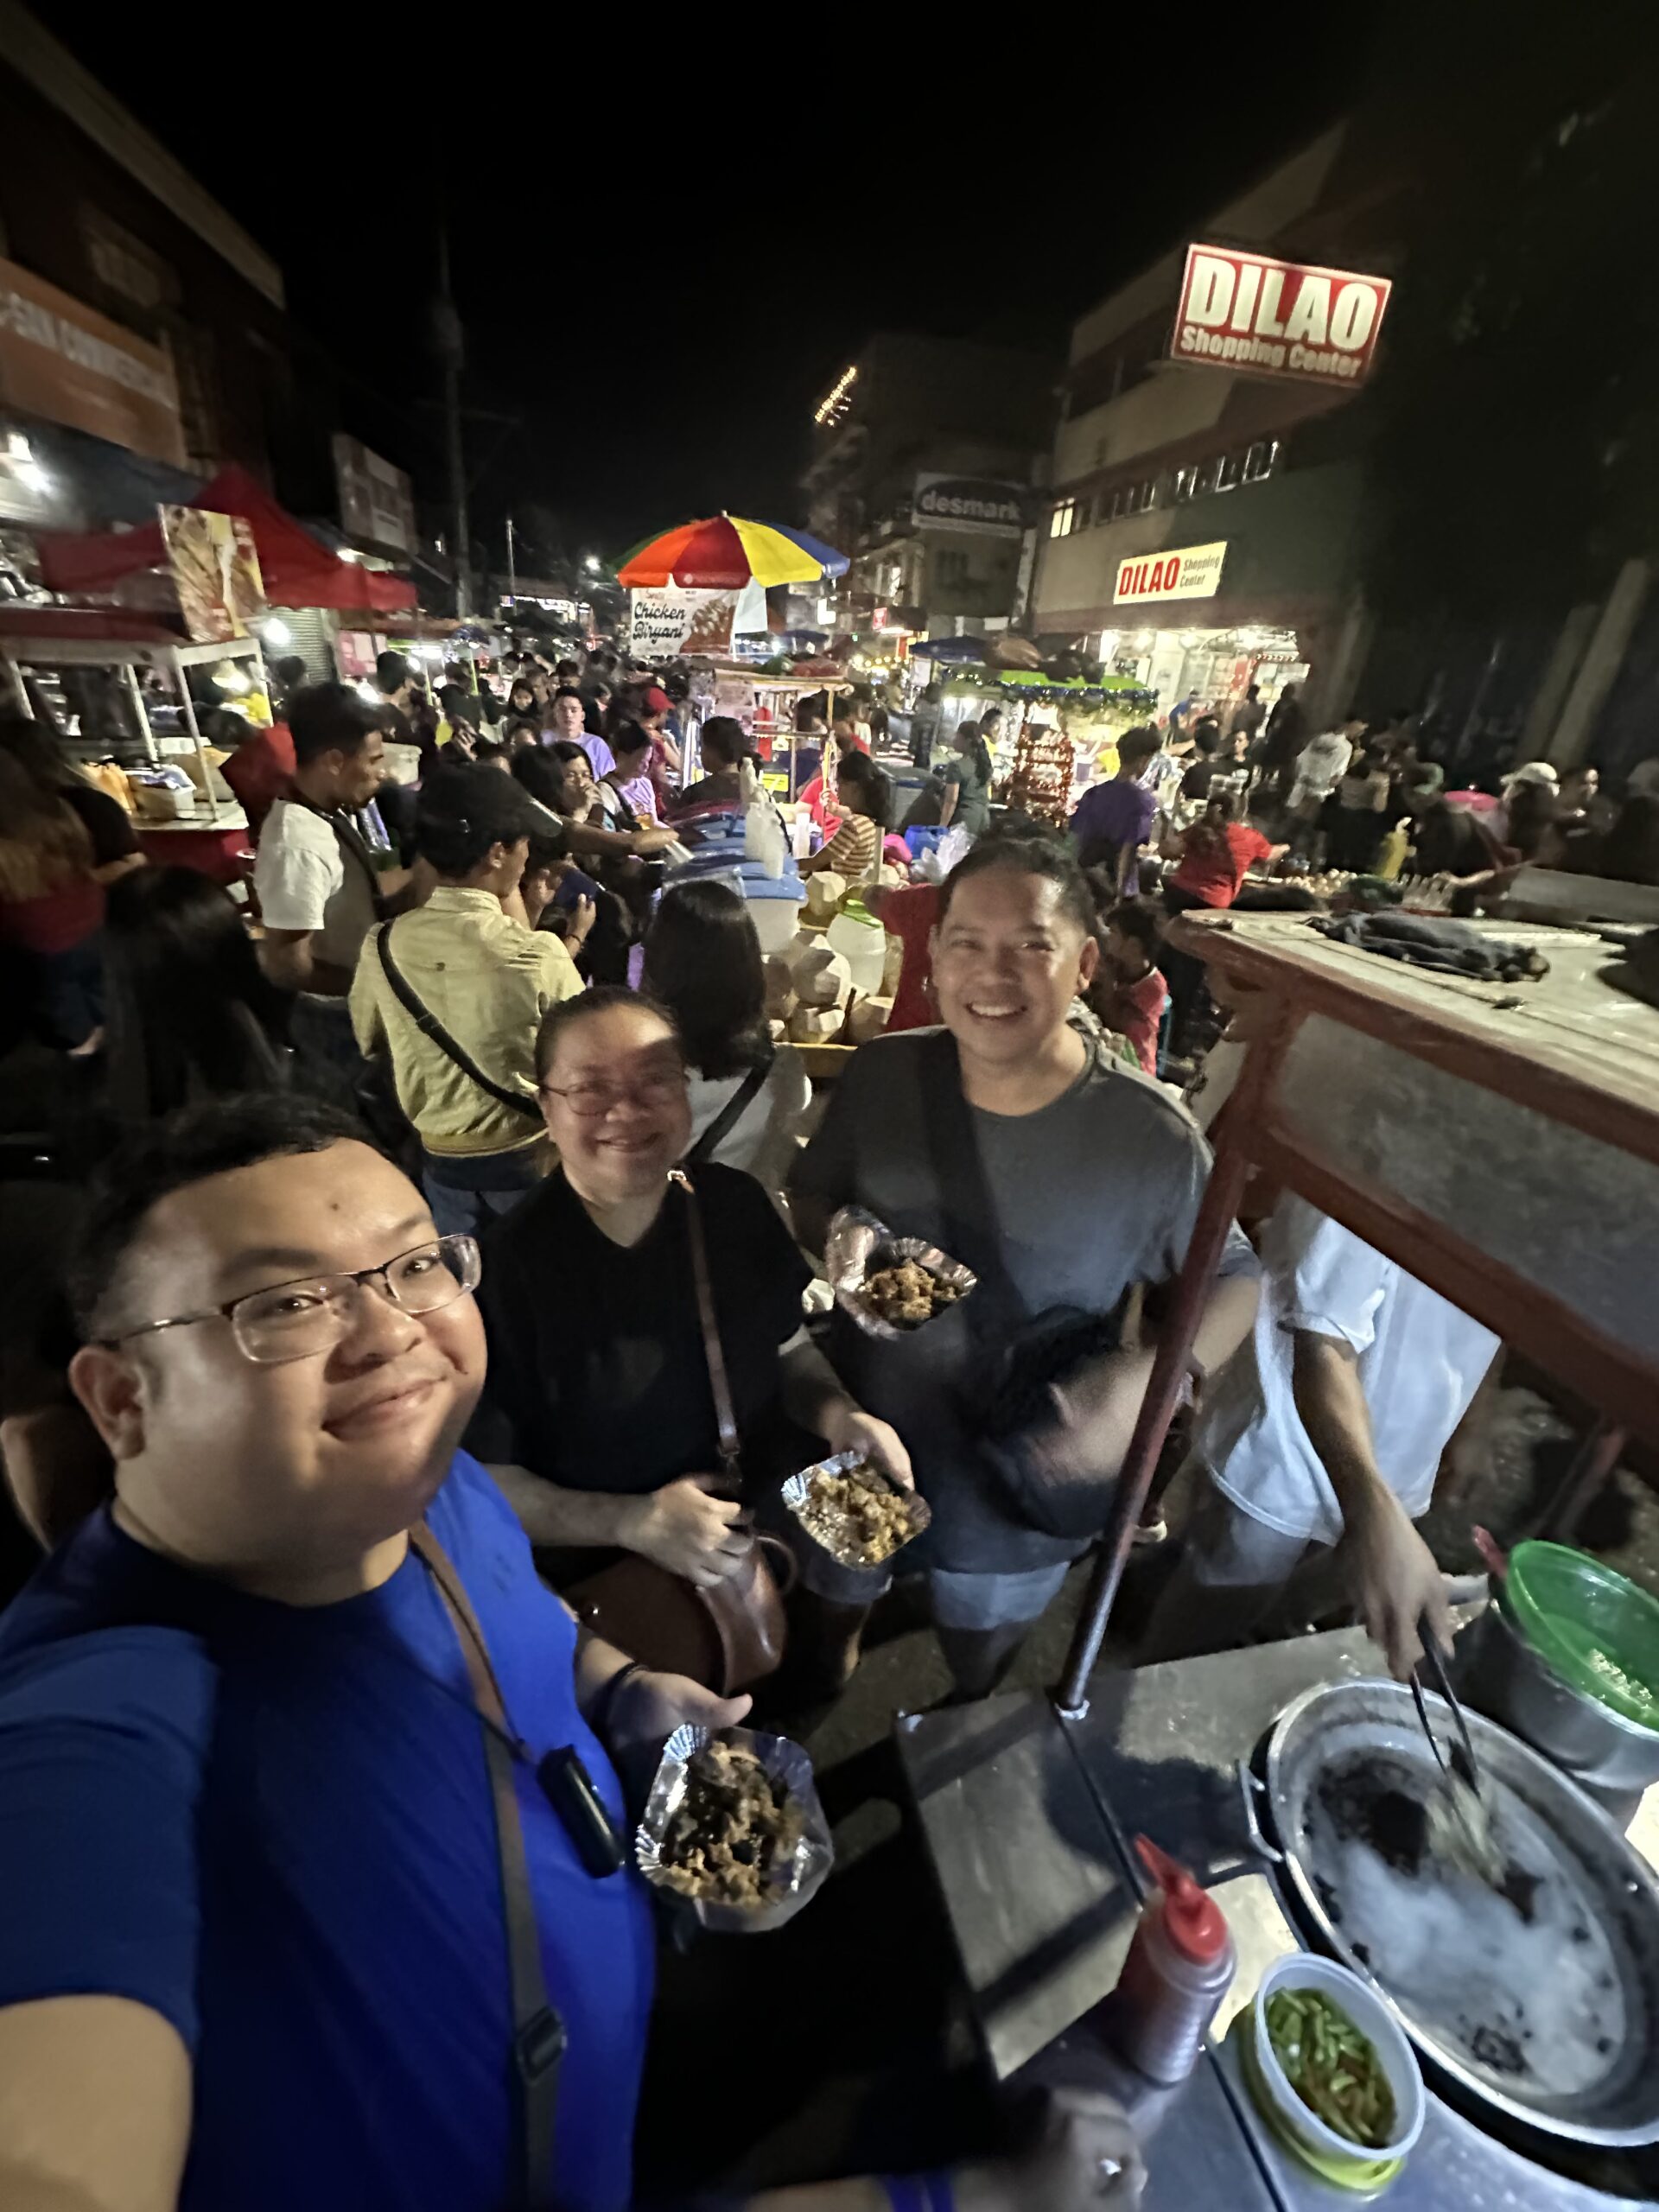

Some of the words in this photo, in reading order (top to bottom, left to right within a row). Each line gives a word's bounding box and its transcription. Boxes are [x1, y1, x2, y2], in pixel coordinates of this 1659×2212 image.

[1185, 255, 1377, 351] DILAO
[1180, 325, 1286, 367] Shopping
[1289, 343, 1362, 378] Center
[922, 490, 1020, 520] desmark
[1119, 556, 1180, 595] DILAO
[1184, 555, 1220, 571] Shopping
[1180, 575, 1205, 588] Center
[634, 602, 686, 620] Chicken
[632, 620, 685, 644] Biryani
